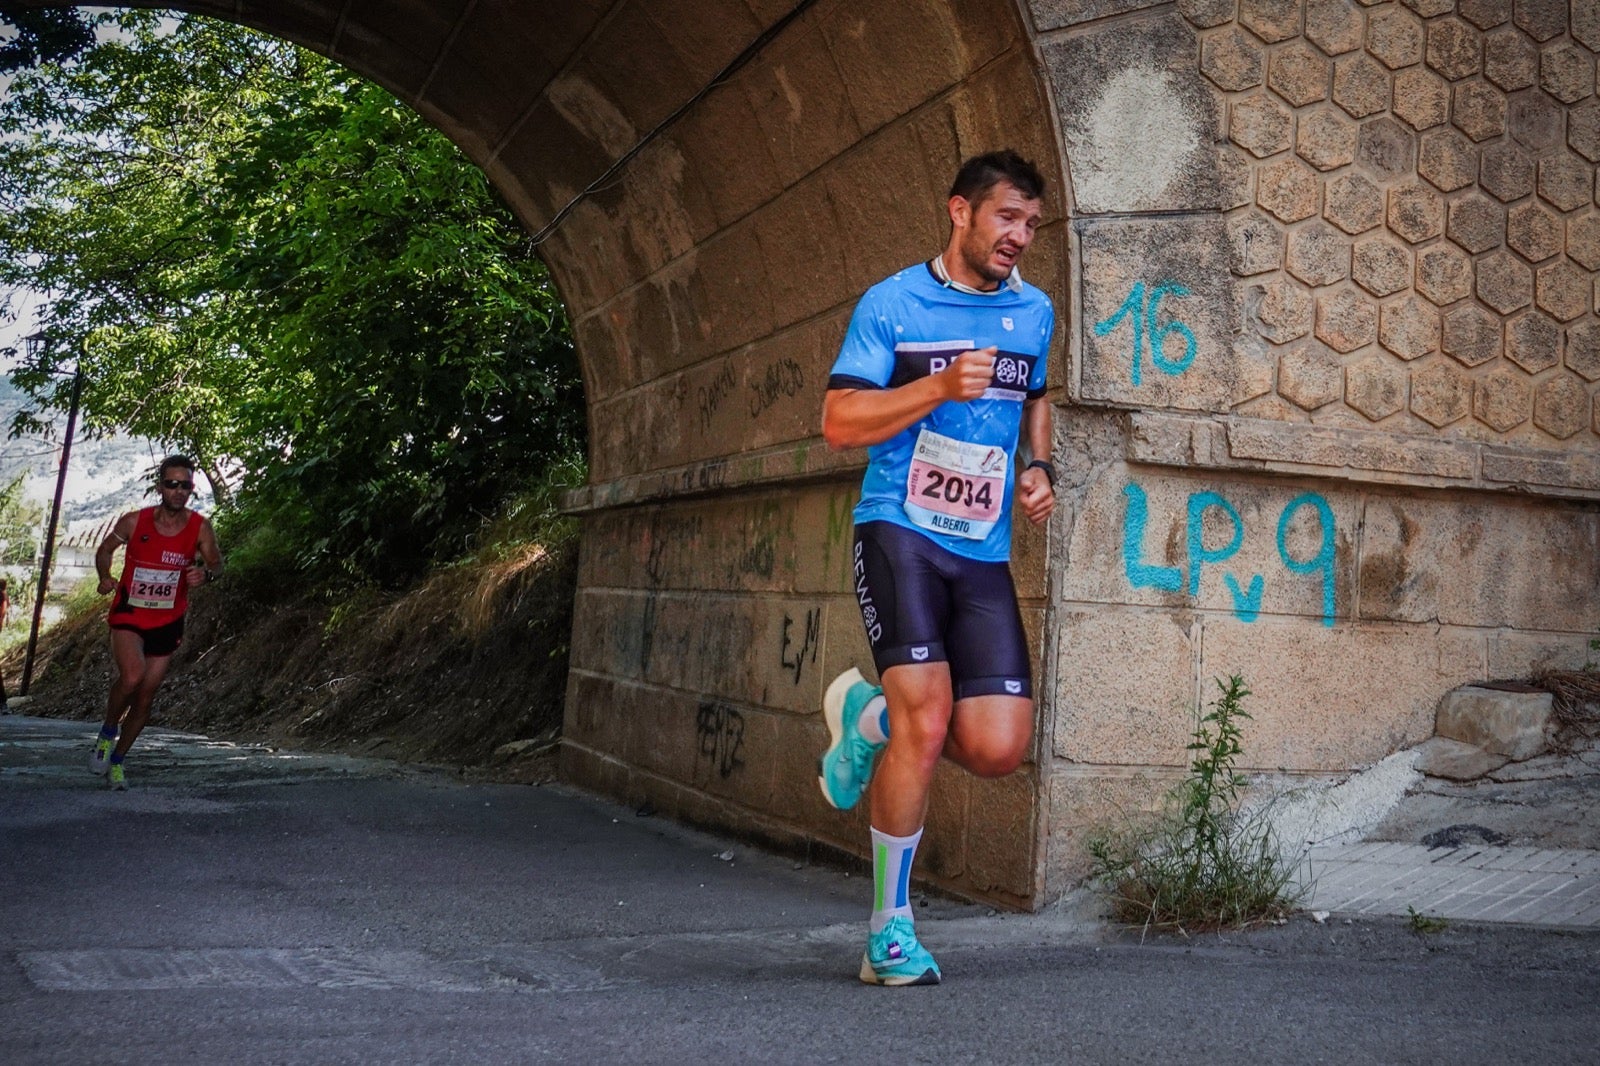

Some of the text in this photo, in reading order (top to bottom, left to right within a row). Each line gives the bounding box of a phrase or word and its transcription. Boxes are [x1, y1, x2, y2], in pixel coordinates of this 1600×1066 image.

[1094, 279, 1197, 387] 16
[921, 469, 993, 510] 2034
[931, 514, 970, 533] ALBERTO
[137, 583, 172, 597] 2148
